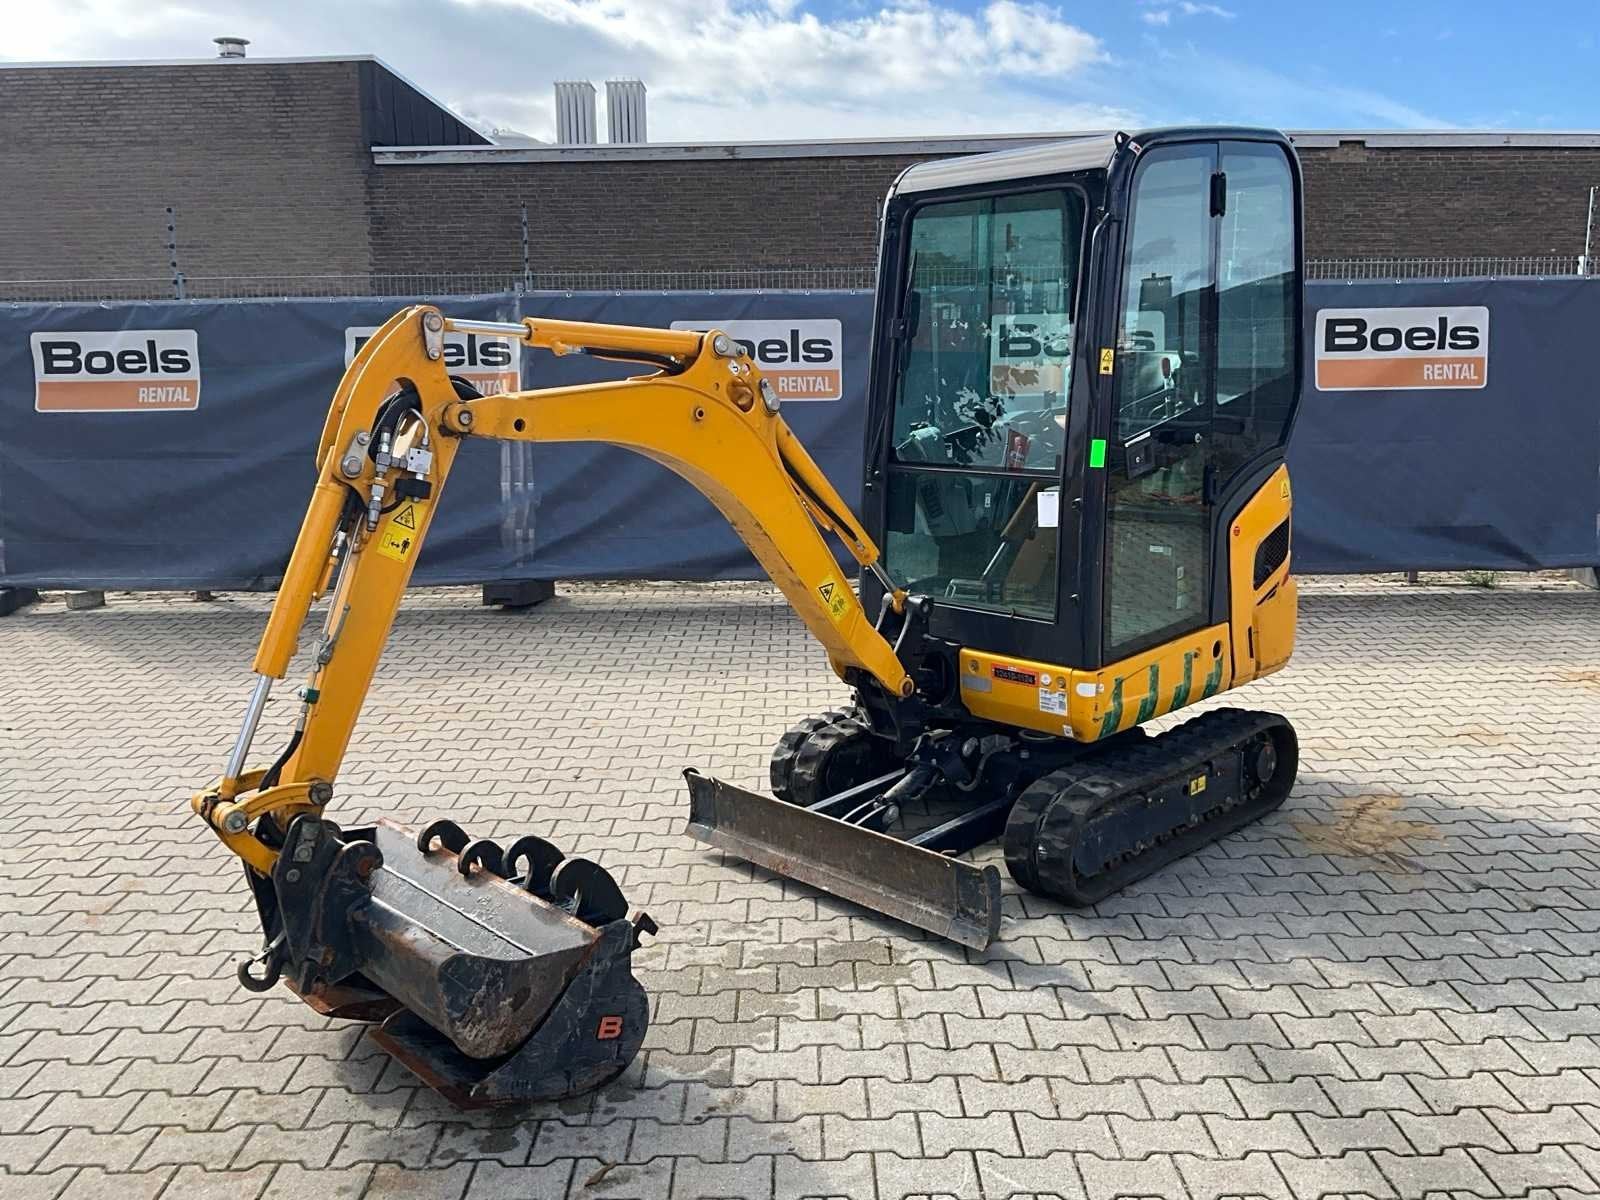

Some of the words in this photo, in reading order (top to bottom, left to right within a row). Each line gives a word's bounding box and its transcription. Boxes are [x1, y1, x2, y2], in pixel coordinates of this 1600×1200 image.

[695, 329, 834, 363] els
[1325, 316, 1480, 352] Boels
[40, 340, 191, 375] Boels
[778, 376, 833, 393] RENTAL
[1423, 363, 1479, 381] RENTAL
[138, 386, 191, 403] RENTAL
[597, 1015, 624, 1040] B
